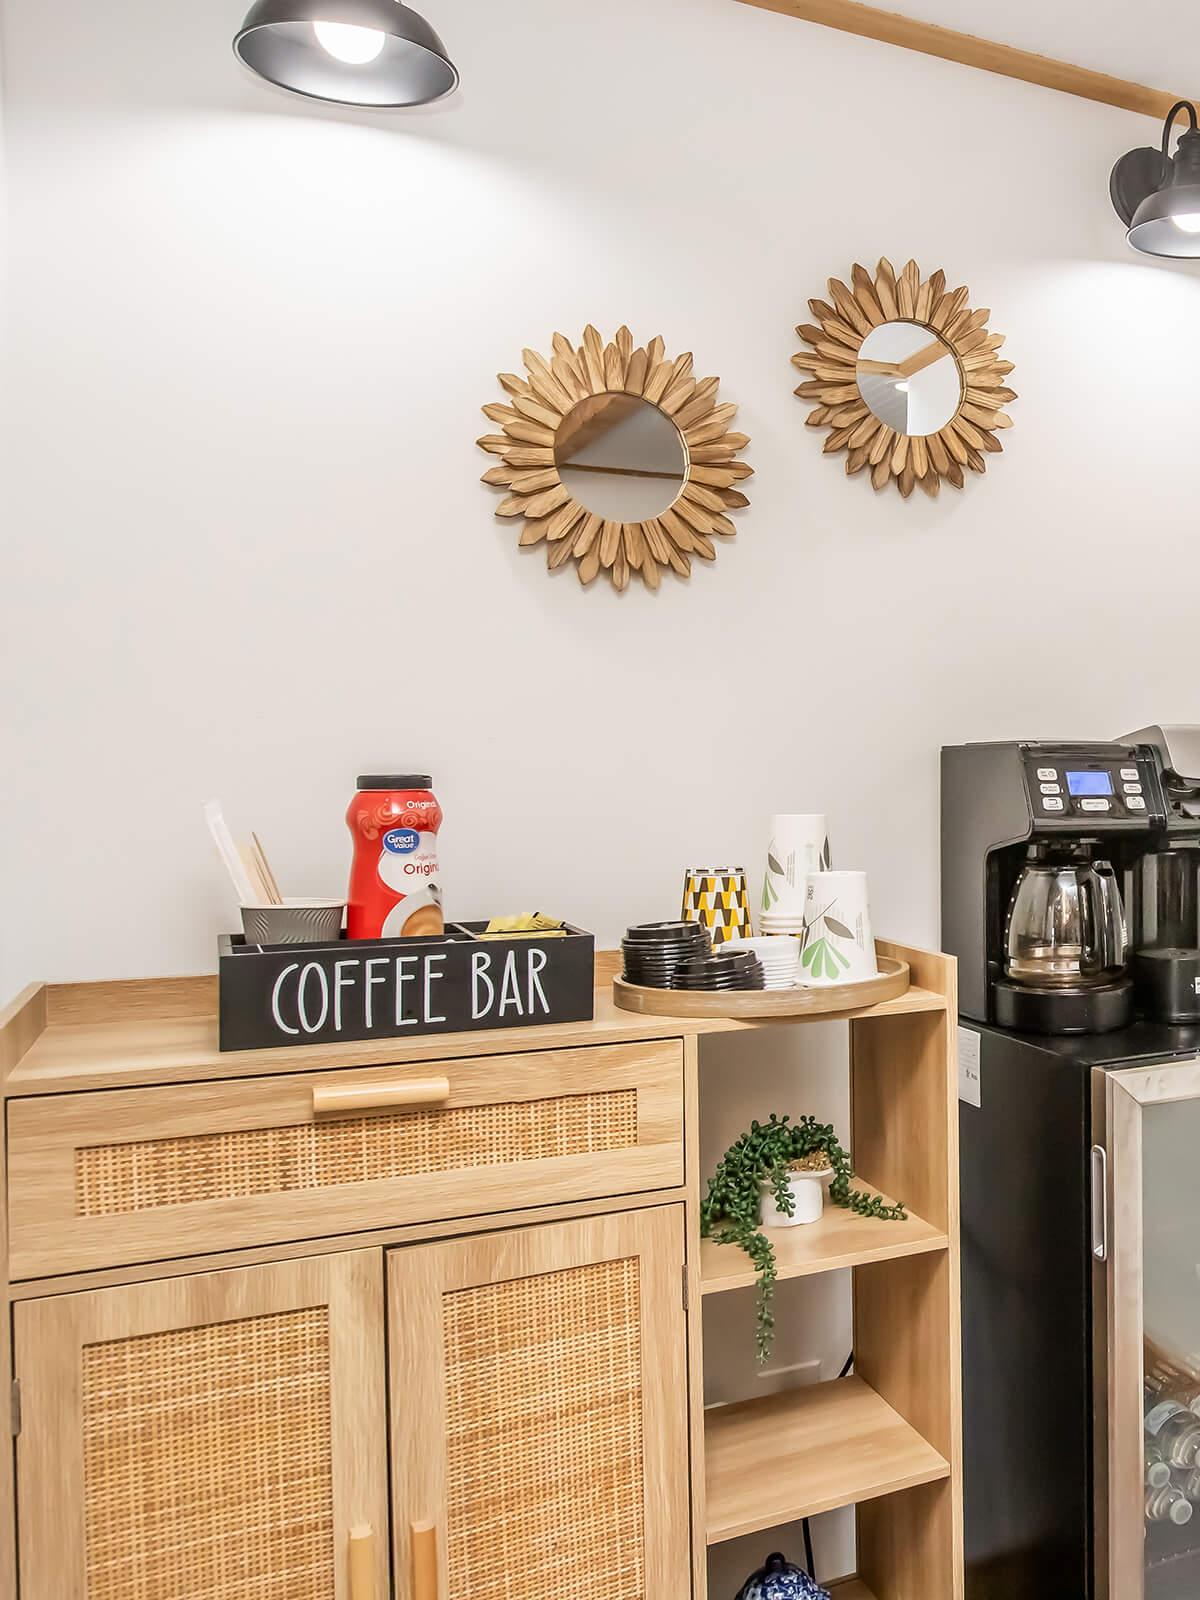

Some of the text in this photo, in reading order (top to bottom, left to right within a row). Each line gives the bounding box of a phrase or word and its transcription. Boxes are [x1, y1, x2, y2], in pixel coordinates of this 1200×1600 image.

[387, 834, 415, 844] Great
[403, 861, 439, 876] Origin
[272, 948, 550, 1034] COFFEE BAR
